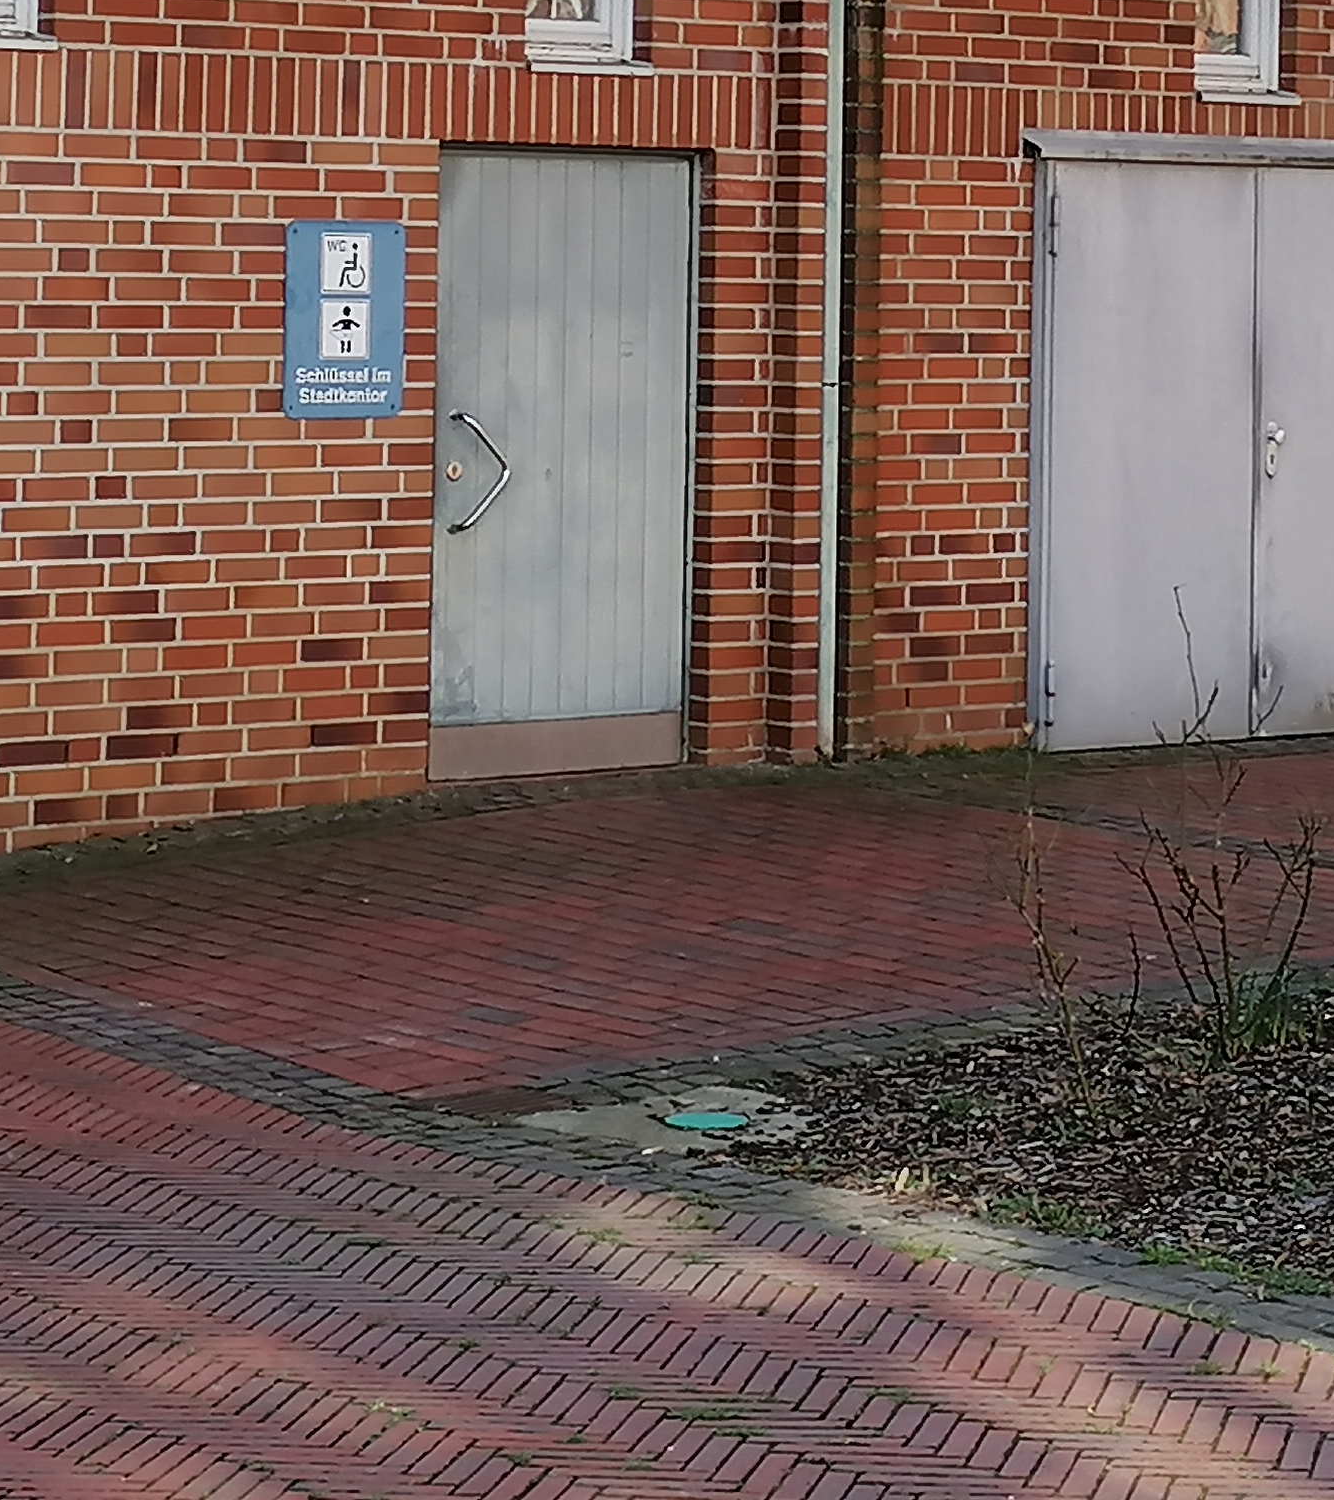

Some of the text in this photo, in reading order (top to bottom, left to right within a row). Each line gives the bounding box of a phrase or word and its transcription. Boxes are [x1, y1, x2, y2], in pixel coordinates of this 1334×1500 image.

[327, 240, 347, 252] WC
[295, 367, 369, 384] Schlüssel
[298, 387, 388, 404] Stadtkontor
